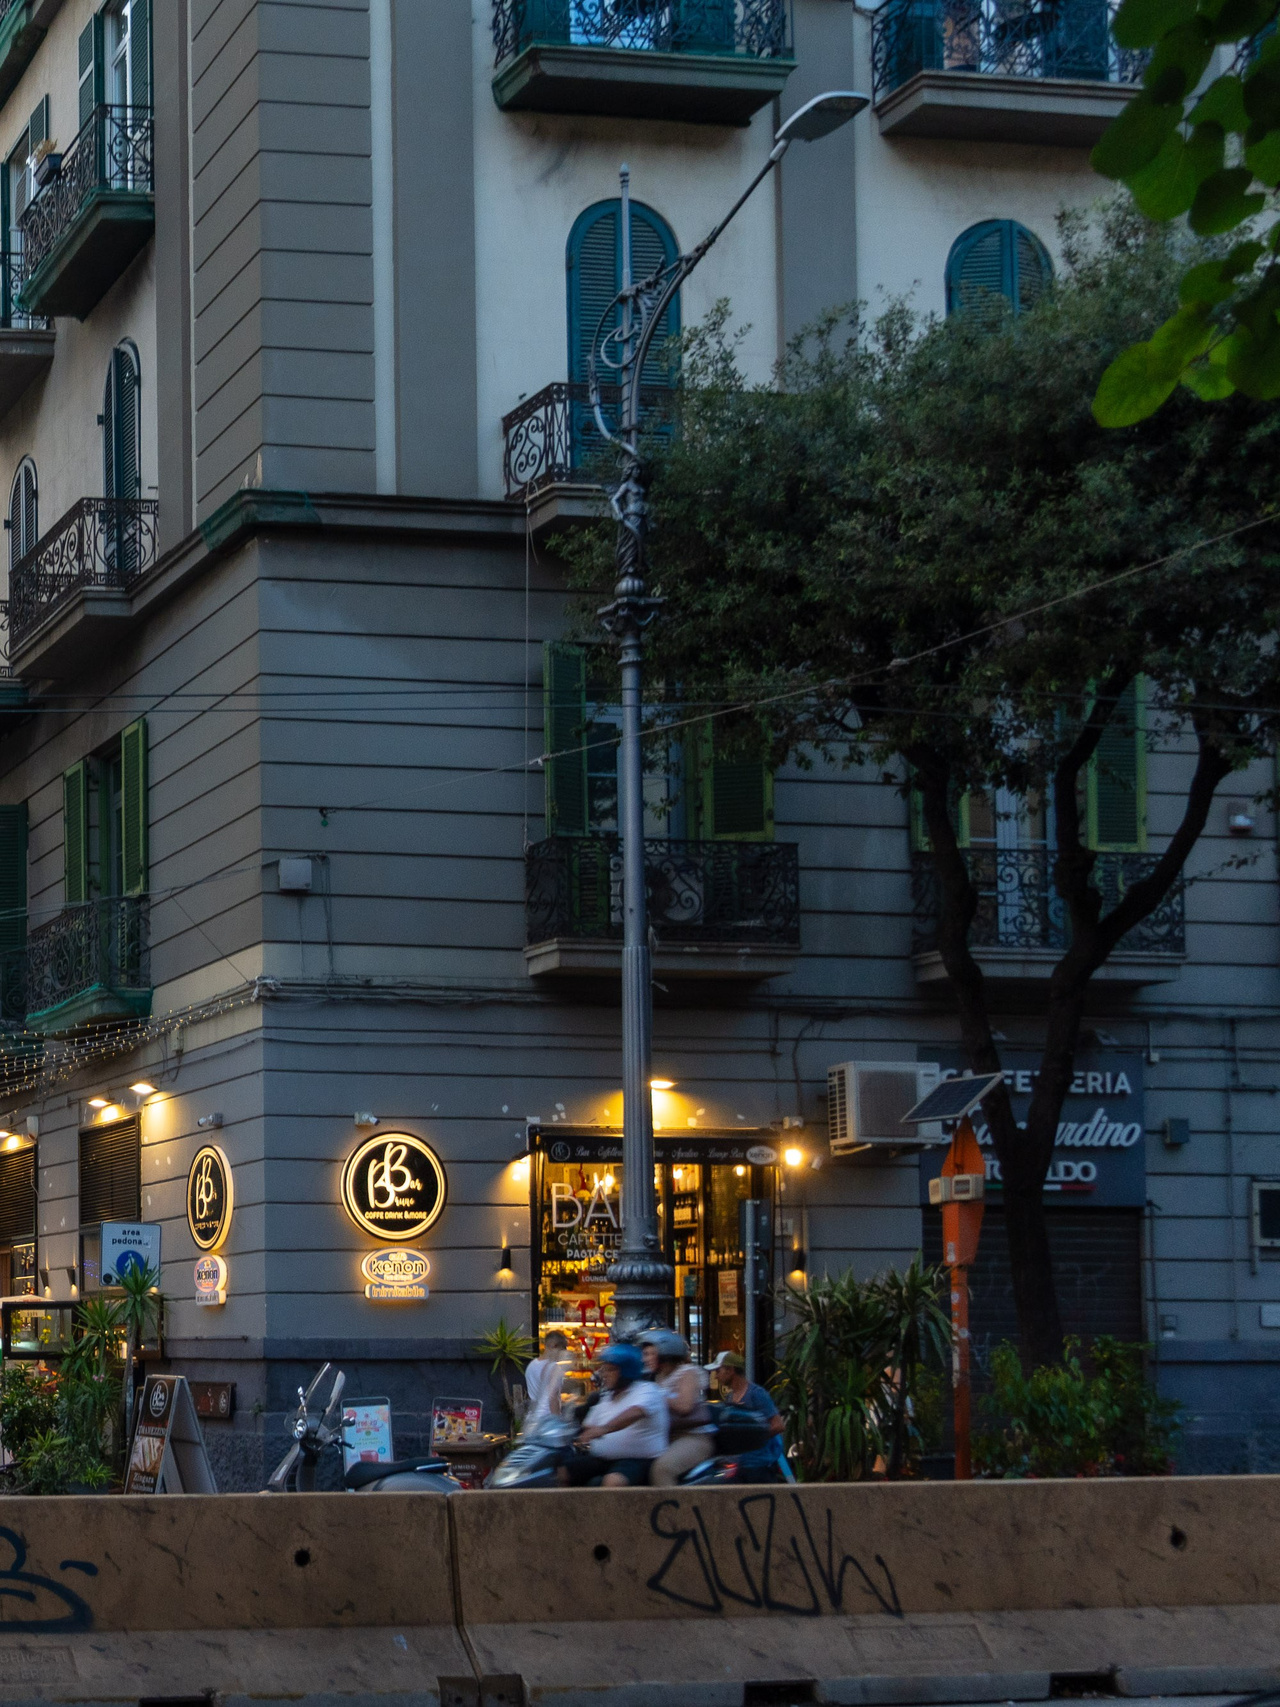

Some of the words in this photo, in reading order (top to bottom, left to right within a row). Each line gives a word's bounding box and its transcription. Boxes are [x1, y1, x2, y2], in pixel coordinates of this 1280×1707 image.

[550, 1182, 624, 1229] BA
[364, 1211, 384, 1220] COFFE
[384, 1211, 404, 1220] DRINK
[372, 1258, 426, 1275] kenon
